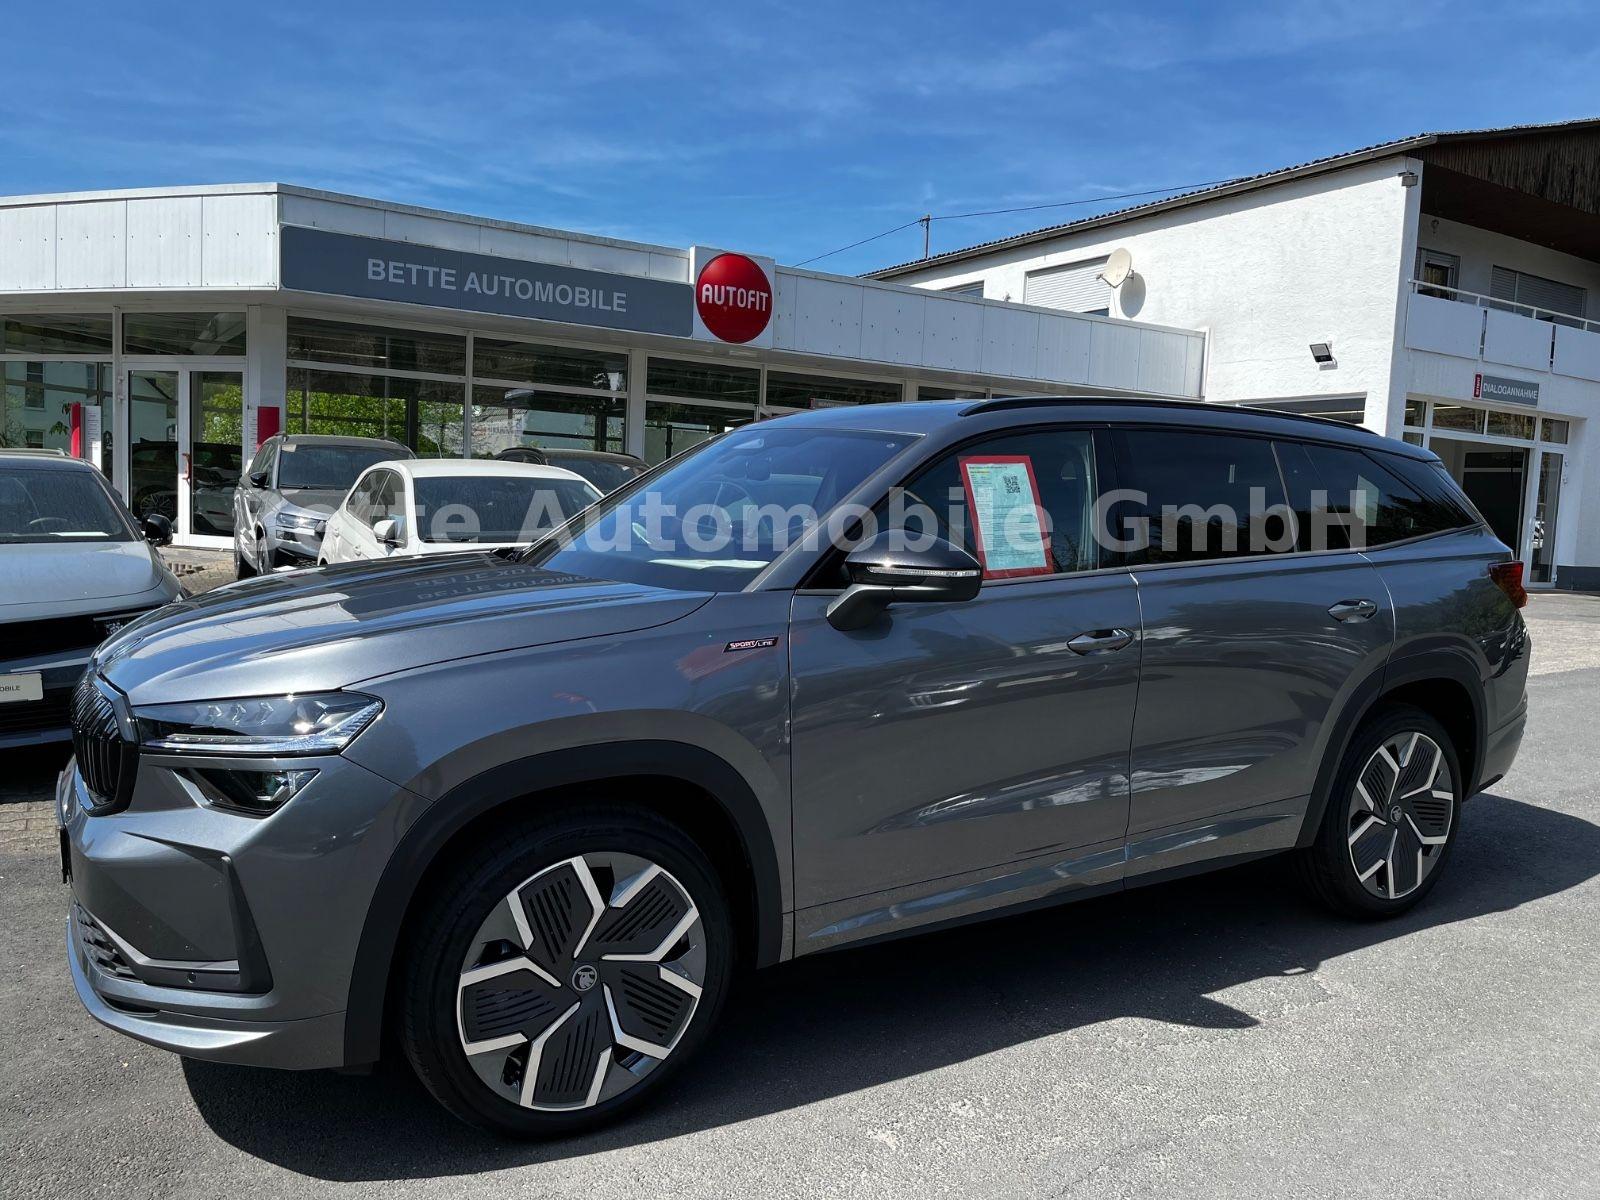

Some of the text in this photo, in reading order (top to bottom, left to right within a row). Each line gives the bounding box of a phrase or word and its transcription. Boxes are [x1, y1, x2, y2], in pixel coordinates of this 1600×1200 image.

[367, 258, 628, 313] BETTE AUTOMOBILE
[701, 283, 768, 312] AUTOFIT
[1483, 382, 1539, 399] DIALOGANNAHME
